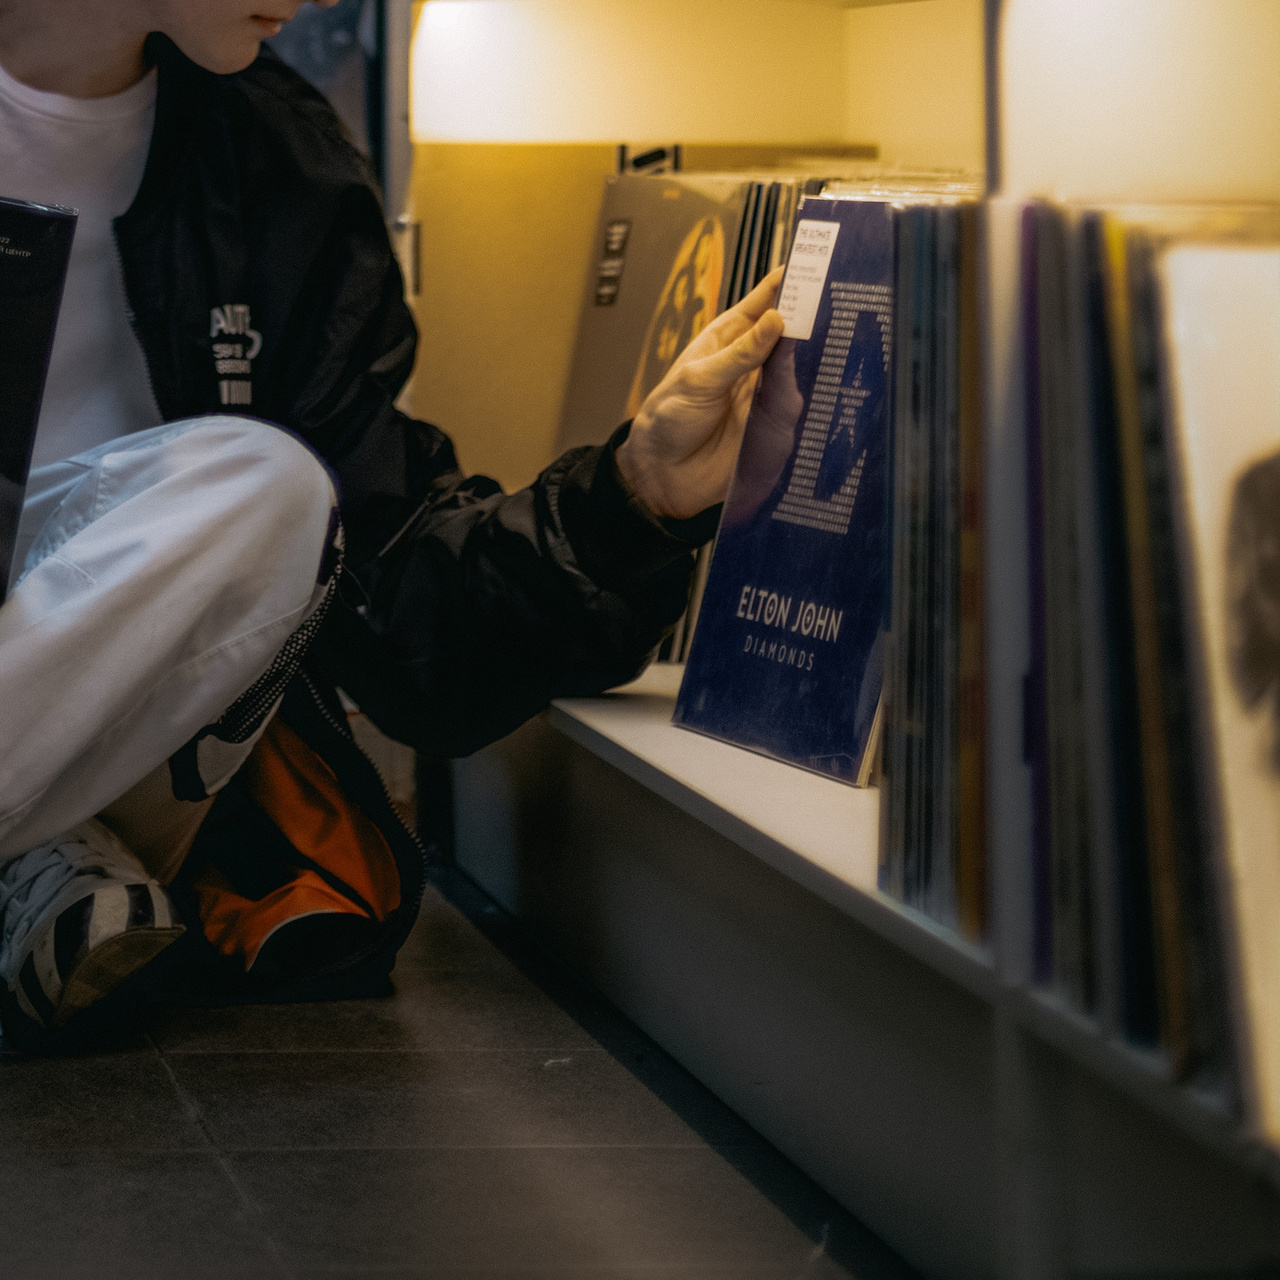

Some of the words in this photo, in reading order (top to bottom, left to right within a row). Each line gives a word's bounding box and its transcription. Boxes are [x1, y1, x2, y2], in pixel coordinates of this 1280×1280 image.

[4, 246, 32, 258] ЦЕНТР
[735, 585, 792, 630] ELTON
[790, 599, 844, 643] JOHN
[743, 634, 815, 671] DIAMONDS
